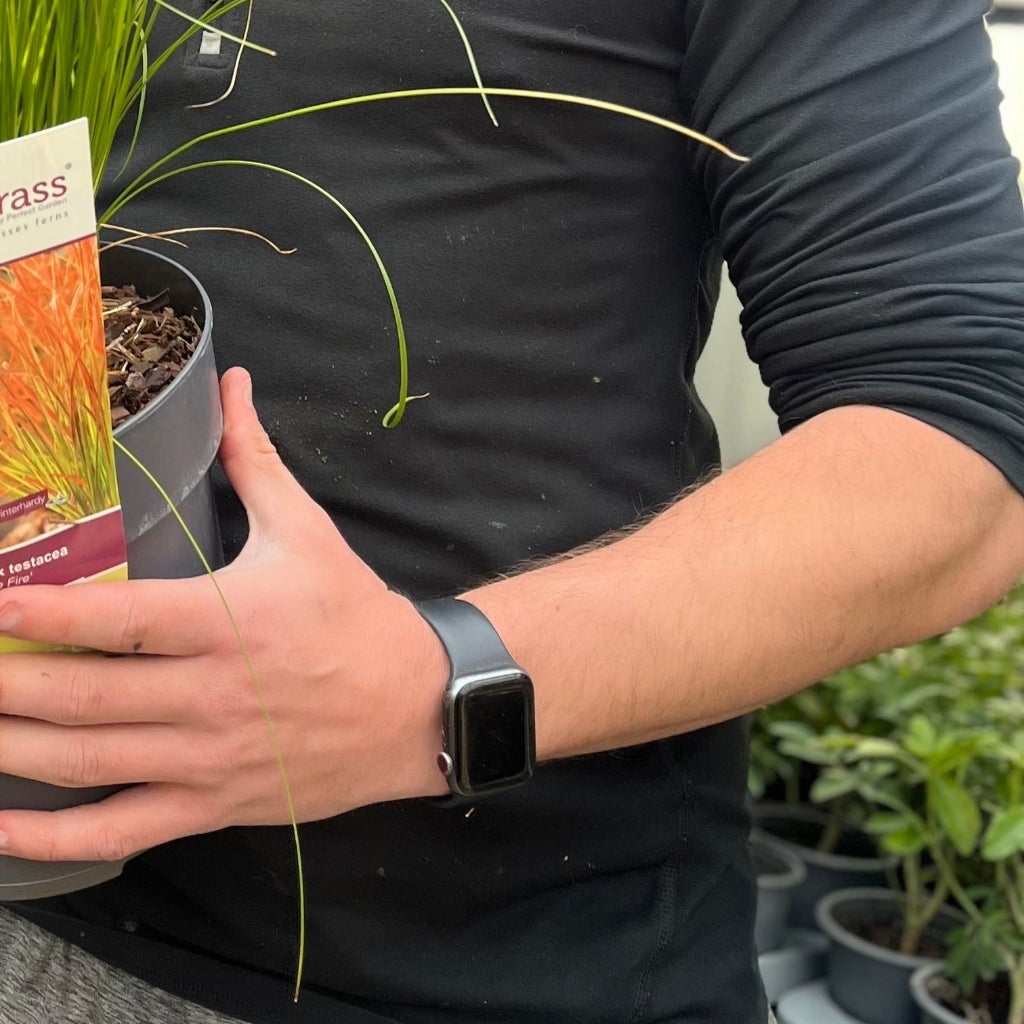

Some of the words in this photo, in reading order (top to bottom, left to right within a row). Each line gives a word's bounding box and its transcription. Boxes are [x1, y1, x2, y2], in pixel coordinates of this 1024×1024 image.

[38, 198, 67, 211] Garden
[35, 211, 70, 226] ferns
[8, 546, 68, 574] testacea
